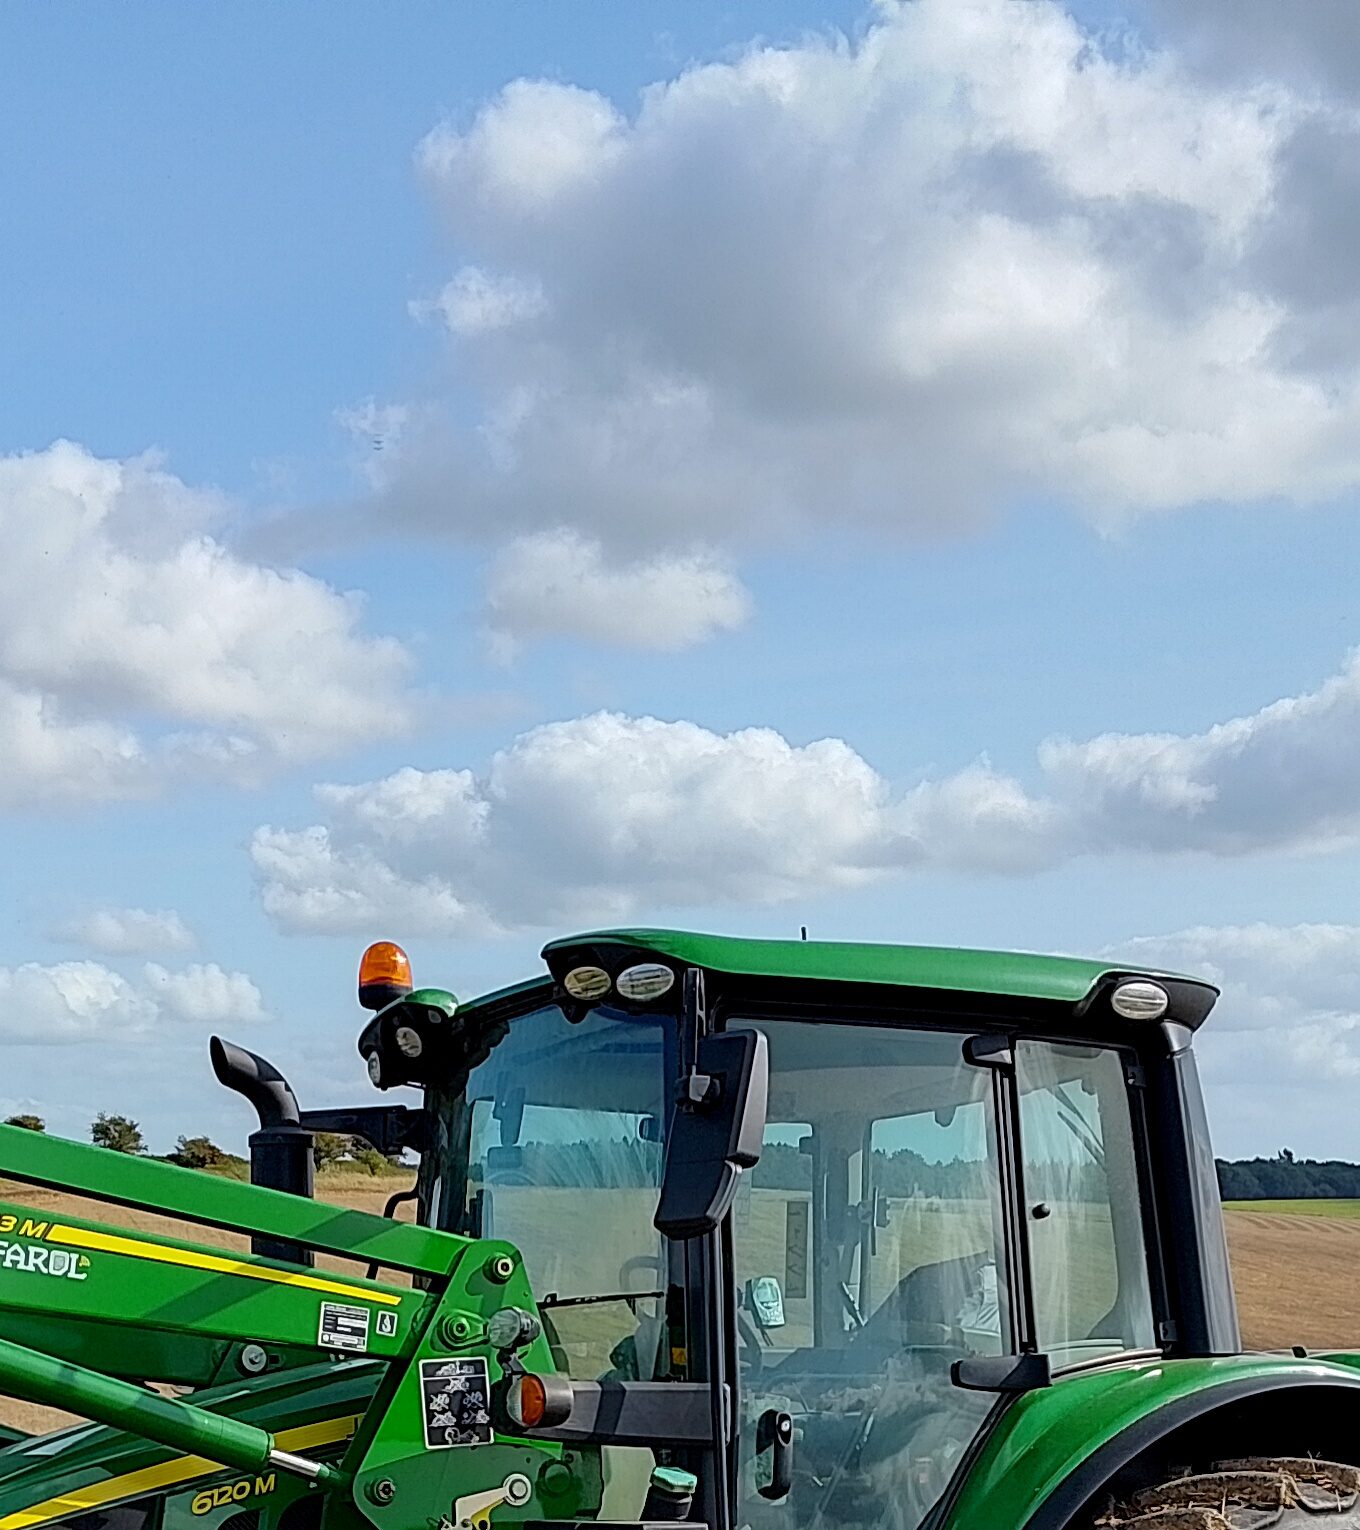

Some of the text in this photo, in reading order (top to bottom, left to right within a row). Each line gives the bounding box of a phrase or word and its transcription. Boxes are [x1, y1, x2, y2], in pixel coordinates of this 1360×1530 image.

[19, 1219, 48, 1238] M
[191, 1473, 276, 1515] 6120 M
